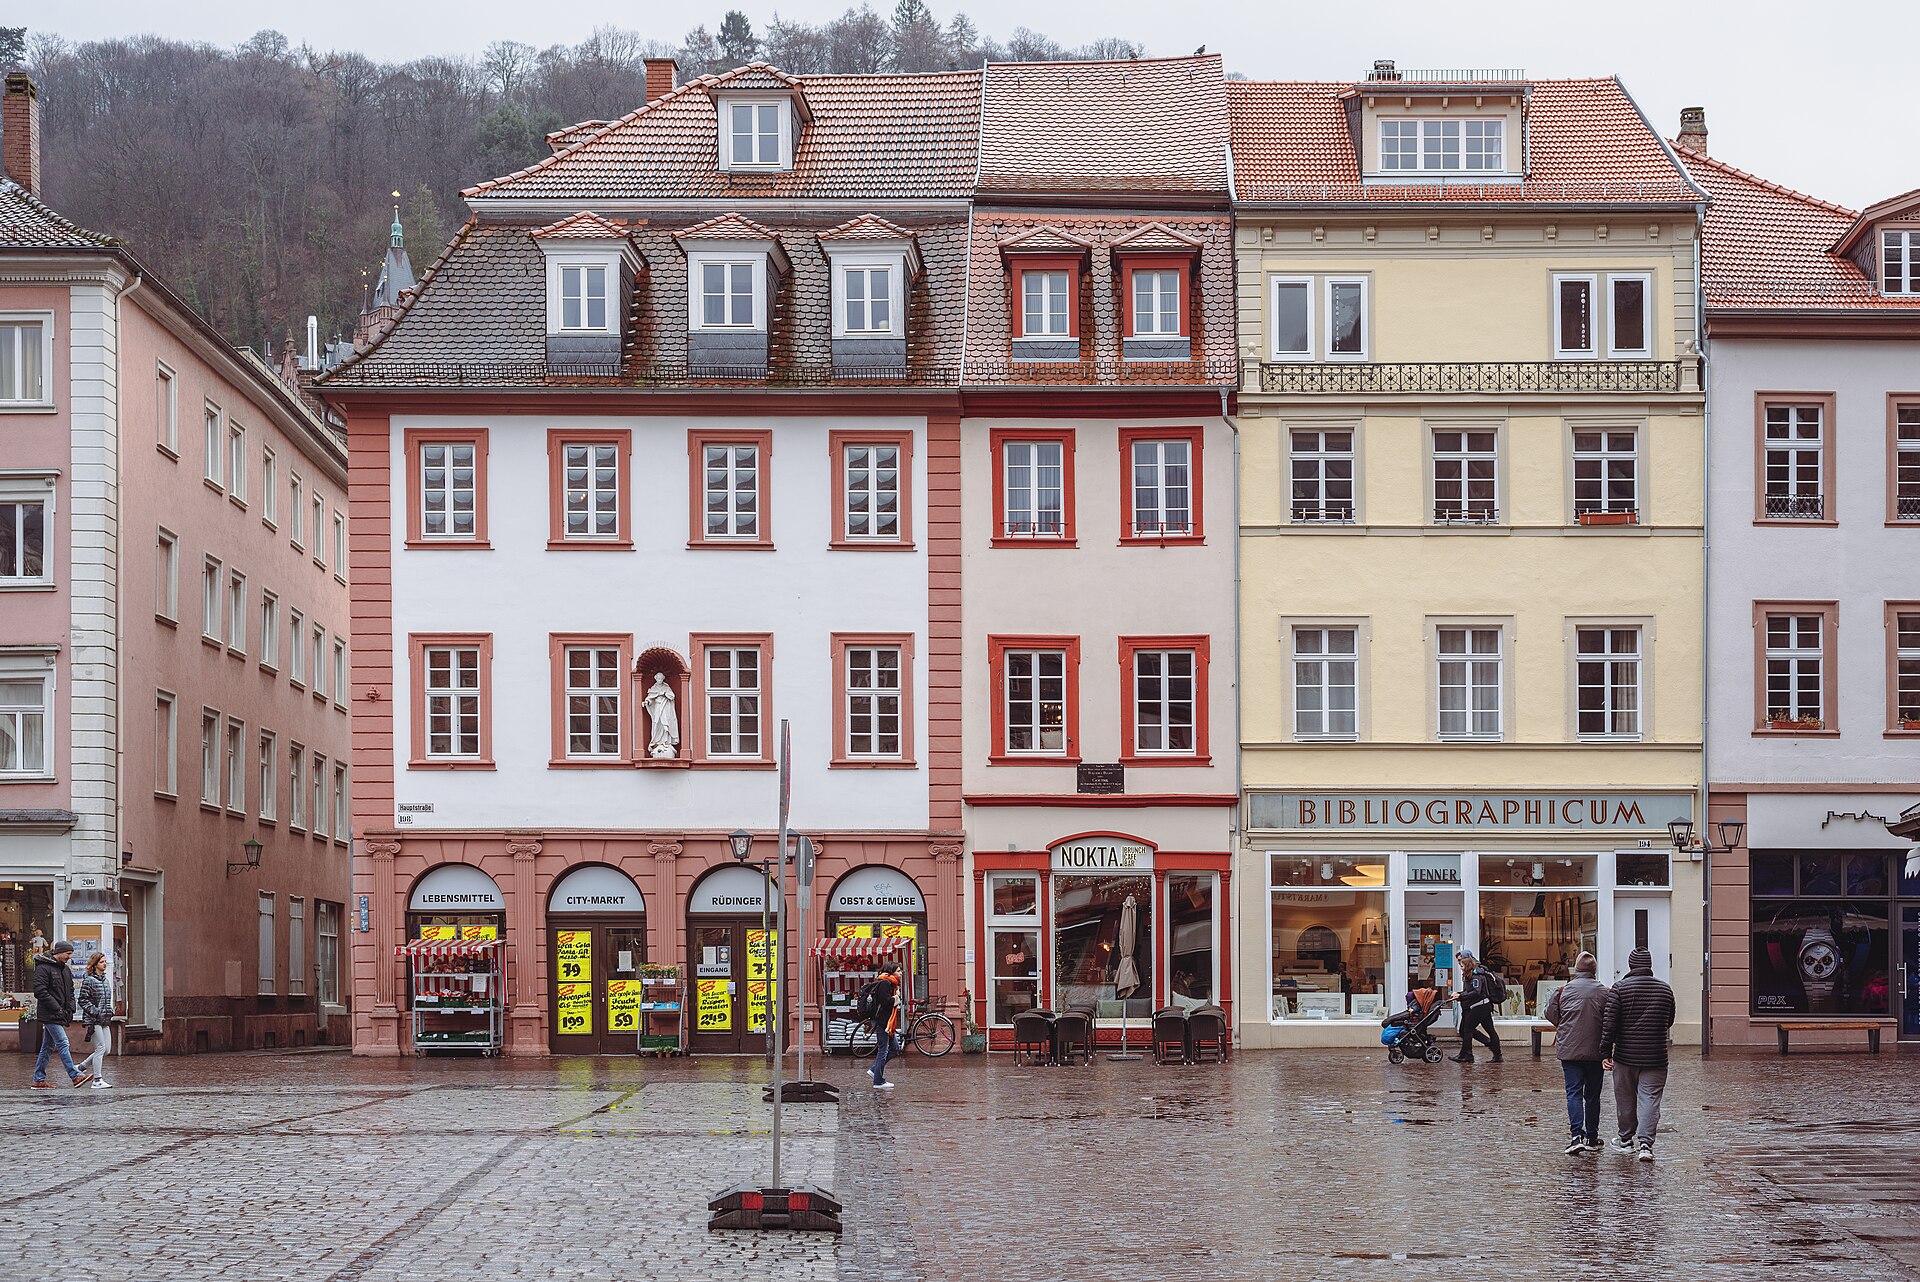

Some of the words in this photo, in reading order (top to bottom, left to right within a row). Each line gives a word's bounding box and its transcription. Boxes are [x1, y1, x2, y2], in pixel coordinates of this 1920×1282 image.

[399, 804, 432, 812] Hauptstraße
[1299, 799, 1646, 825] BIBLIOGRAPHICUM
[1123, 846, 1146, 854] BRUNCH
[1411, 868, 1458, 881] TENNER
[422, 894, 495, 903] LEBENSMITTEL
[566, 896, 626, 905] CITY-MARKT
[711, 894, 762, 905] RÜDINGER
[839, 896, 865, 906] OBST
[866, 897, 874, 906] &
[875, 895, 916, 906] GEMÜSE
[1758, 995, 1787, 1005] PRX
